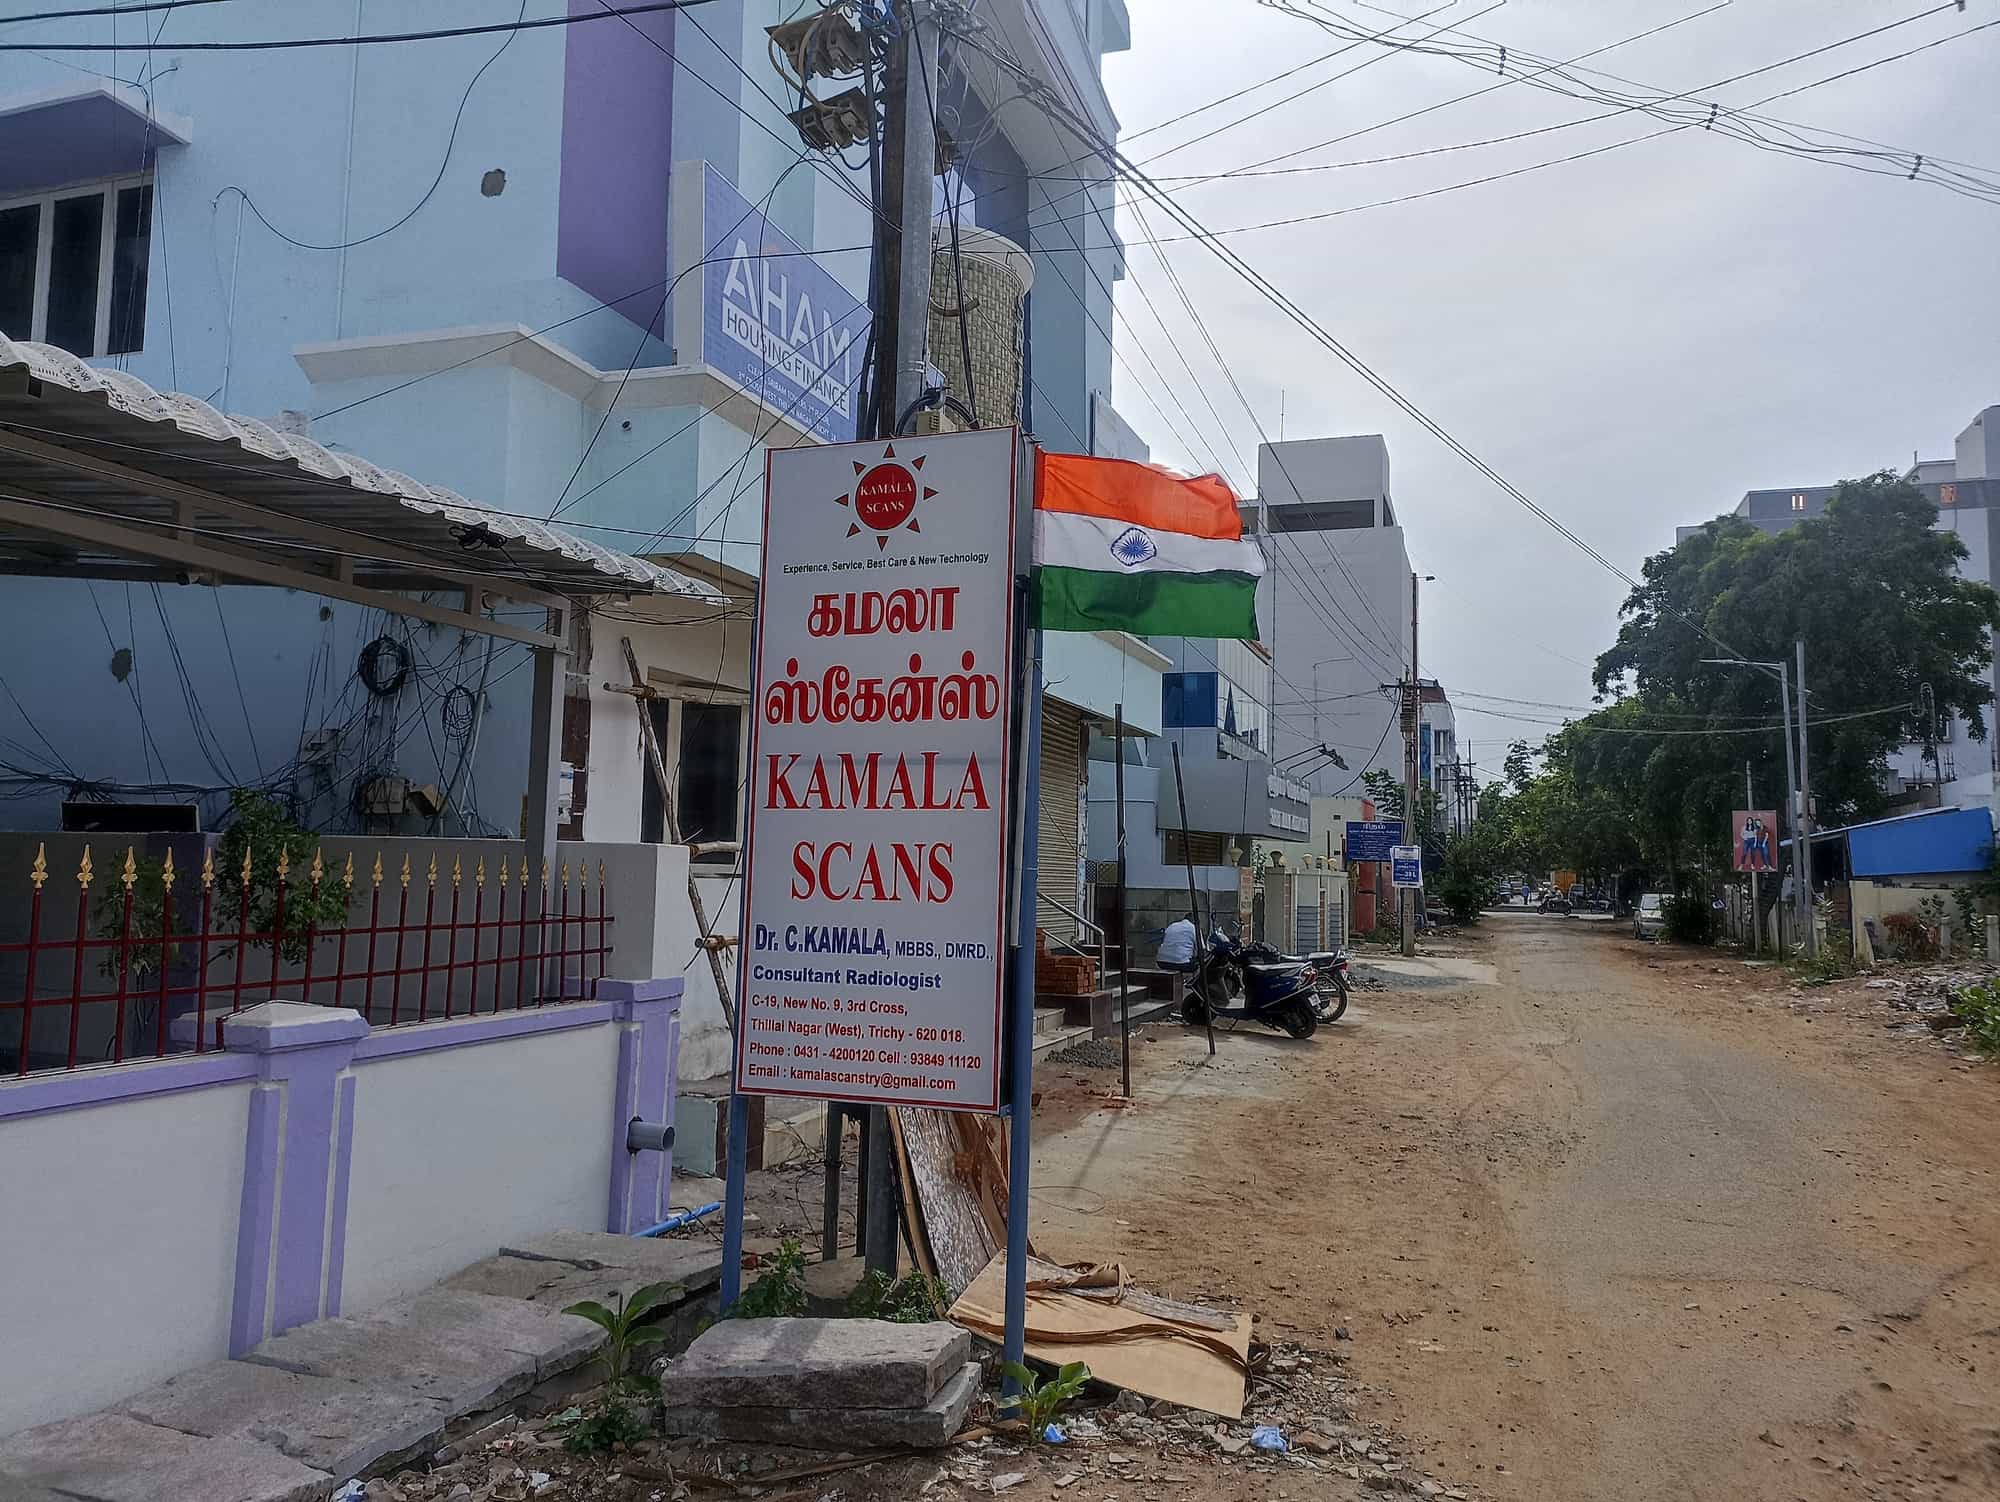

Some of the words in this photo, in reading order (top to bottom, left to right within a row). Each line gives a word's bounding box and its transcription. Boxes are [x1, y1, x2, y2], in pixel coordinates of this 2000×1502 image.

[723, 237, 849, 385] AHAM
[727, 308, 792, 371] HOUSING
[795, 358, 847, 412] FINANCE
[860, 484, 912, 497] KAMALA
[866, 501, 905, 514] SCANS
[783, 562, 830, 575] Experience,
[832, 560, 865, 572] Service,
[867, 559, 886, 569] Best
[888, 557, 907, 567] Care
[910, 556, 916, 565] &
[918, 556, 936, 565] New
[940, 552, 989, 563] Technology
[807, 586, 960, 637] கமலா
[765, 650, 1000, 725] ஸ்கேன்ஸ்
[763, 751, 991, 810] KAMALA
[791, 841, 955, 903] SCANS
[755, 924, 779, 950] Dr.
[785, 925, 890, 960] C.KAMALA,
[895, 941, 941, 960] MBBS.,
[945, 942, 993, 961] DMRD.,
[753, 965, 841, 984] Consultant
[846, 969, 942, 991] Radiologist
[752, 994, 780, 1010] C-19,
[783, 997, 808, 1009] New
[811, 998, 830, 1010] No.
[833, 998, 843, 1012] 9,
[847, 1000, 866, 1012] 3rd
[869, 1000, 908, 1016] Cross,
[751, 1018, 785, 1032] Thillai
[788, 1021, 822, 1037] Nagar
[825, 1022, 865, 1039] (West),
[868, 1025, 905, 1042] Trichy
[916, 1027, 937, 1041] 620
[940, 1029, 966, 1043] 018.
[750, 1042, 785, 1056] Phone
[794, 1045, 819, 1058] 0431
[878, 1051, 900, 1064] Cell
[910, 1053, 944, 1066] 93849
[948, 1054, 981, 1069] 11120
[748, 1064, 780, 1078] Email
[790, 1066, 956, 1090] kamalascanstry@gmail.com
